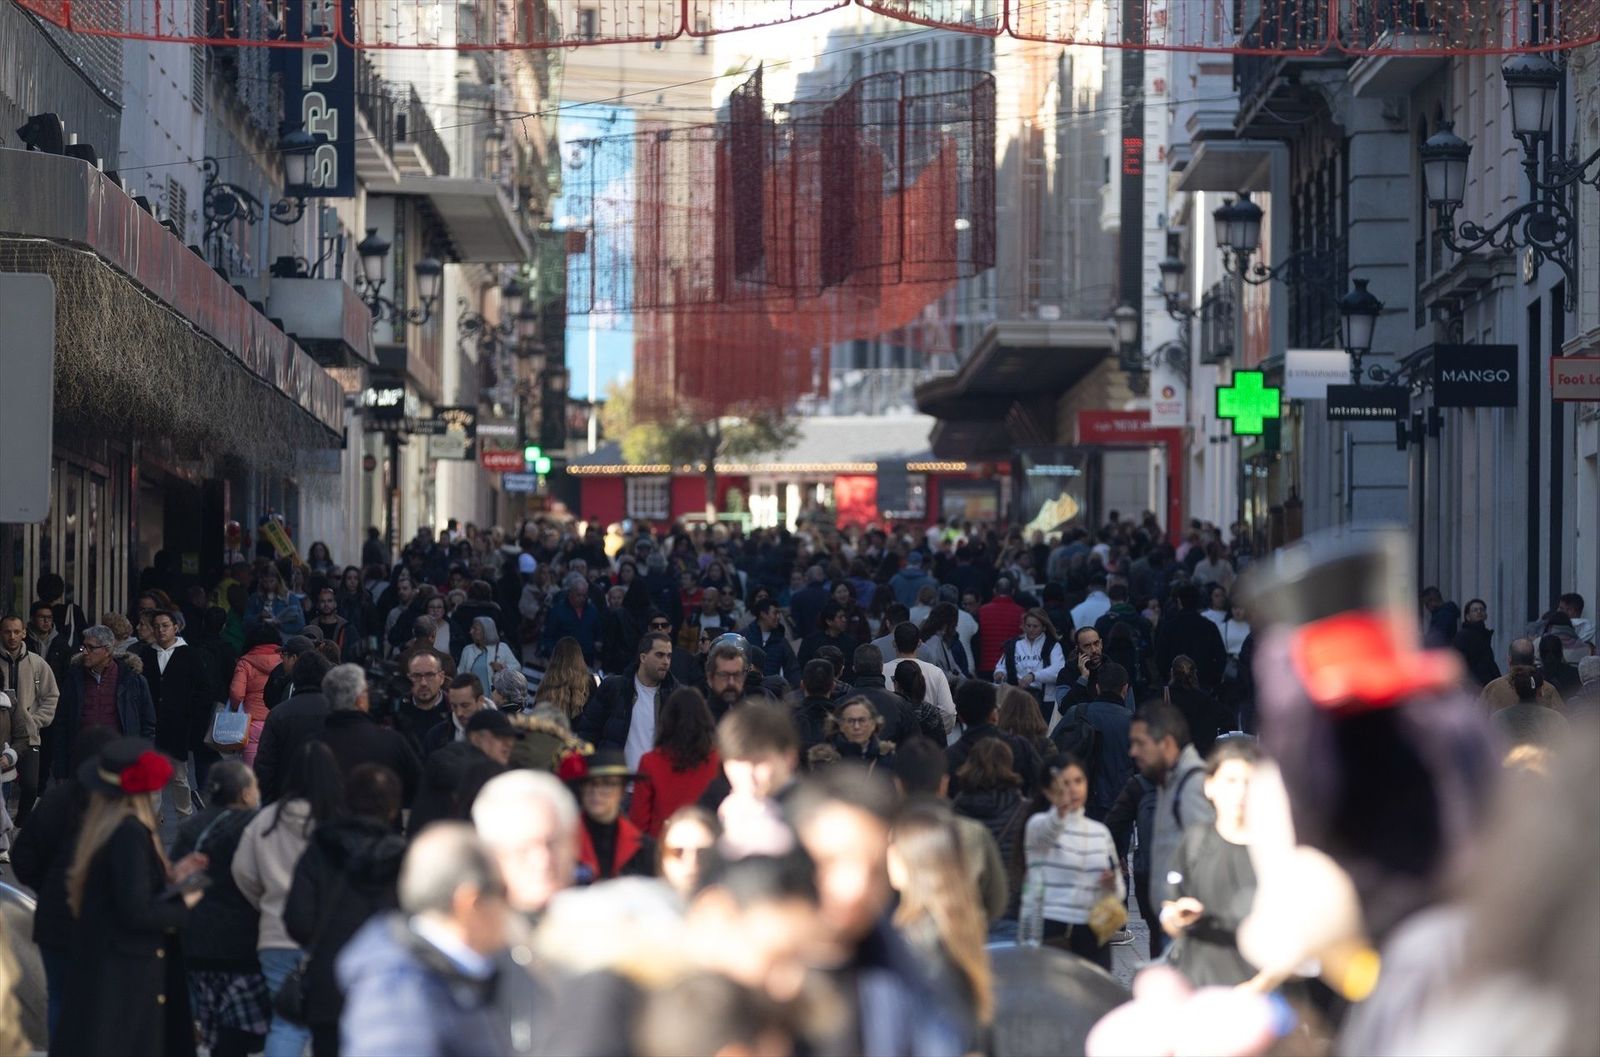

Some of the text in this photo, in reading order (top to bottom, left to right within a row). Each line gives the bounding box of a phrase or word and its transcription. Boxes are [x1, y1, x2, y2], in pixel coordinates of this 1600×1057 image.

[1442, 369, 1510, 382] MANGO
[1558, 373, 1585, 385] Foot
[1330, 407, 1397, 416] intimissimi
